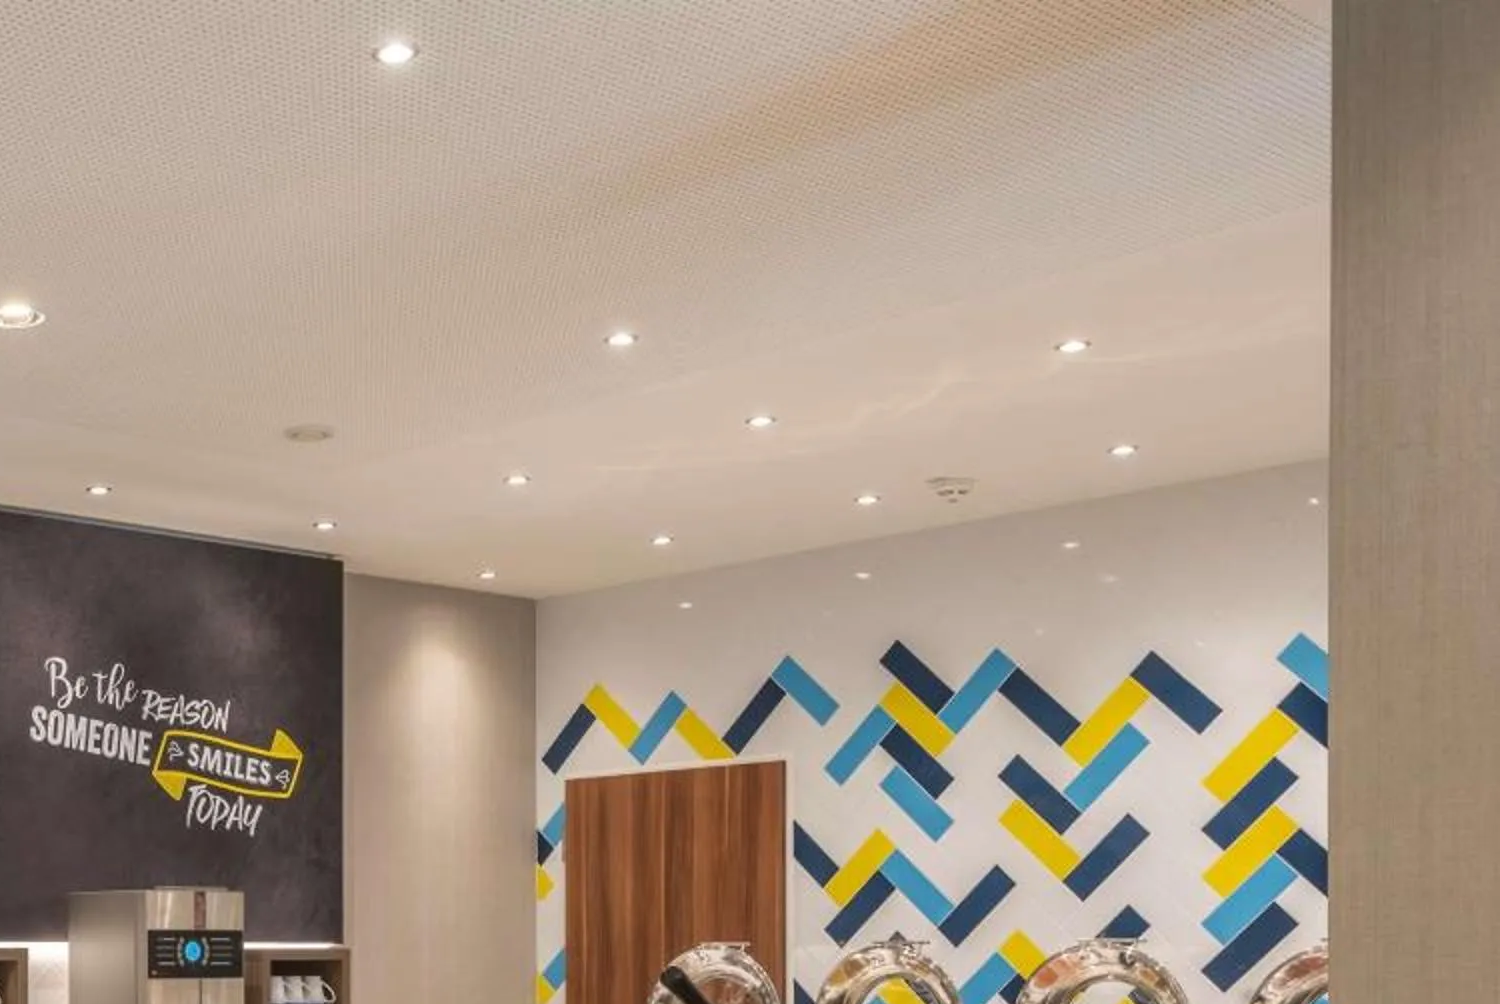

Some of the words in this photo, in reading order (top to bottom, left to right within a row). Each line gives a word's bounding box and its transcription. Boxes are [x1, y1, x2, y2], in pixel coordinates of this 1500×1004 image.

[44, 656, 88, 709] Be
[91, 663, 140, 711] the
[141, 689, 231, 733] REASON
[29, 705, 153, 766] SOMEONE
[186, 741, 272, 786] SMILES
[185, 784, 263, 837] TODAY
